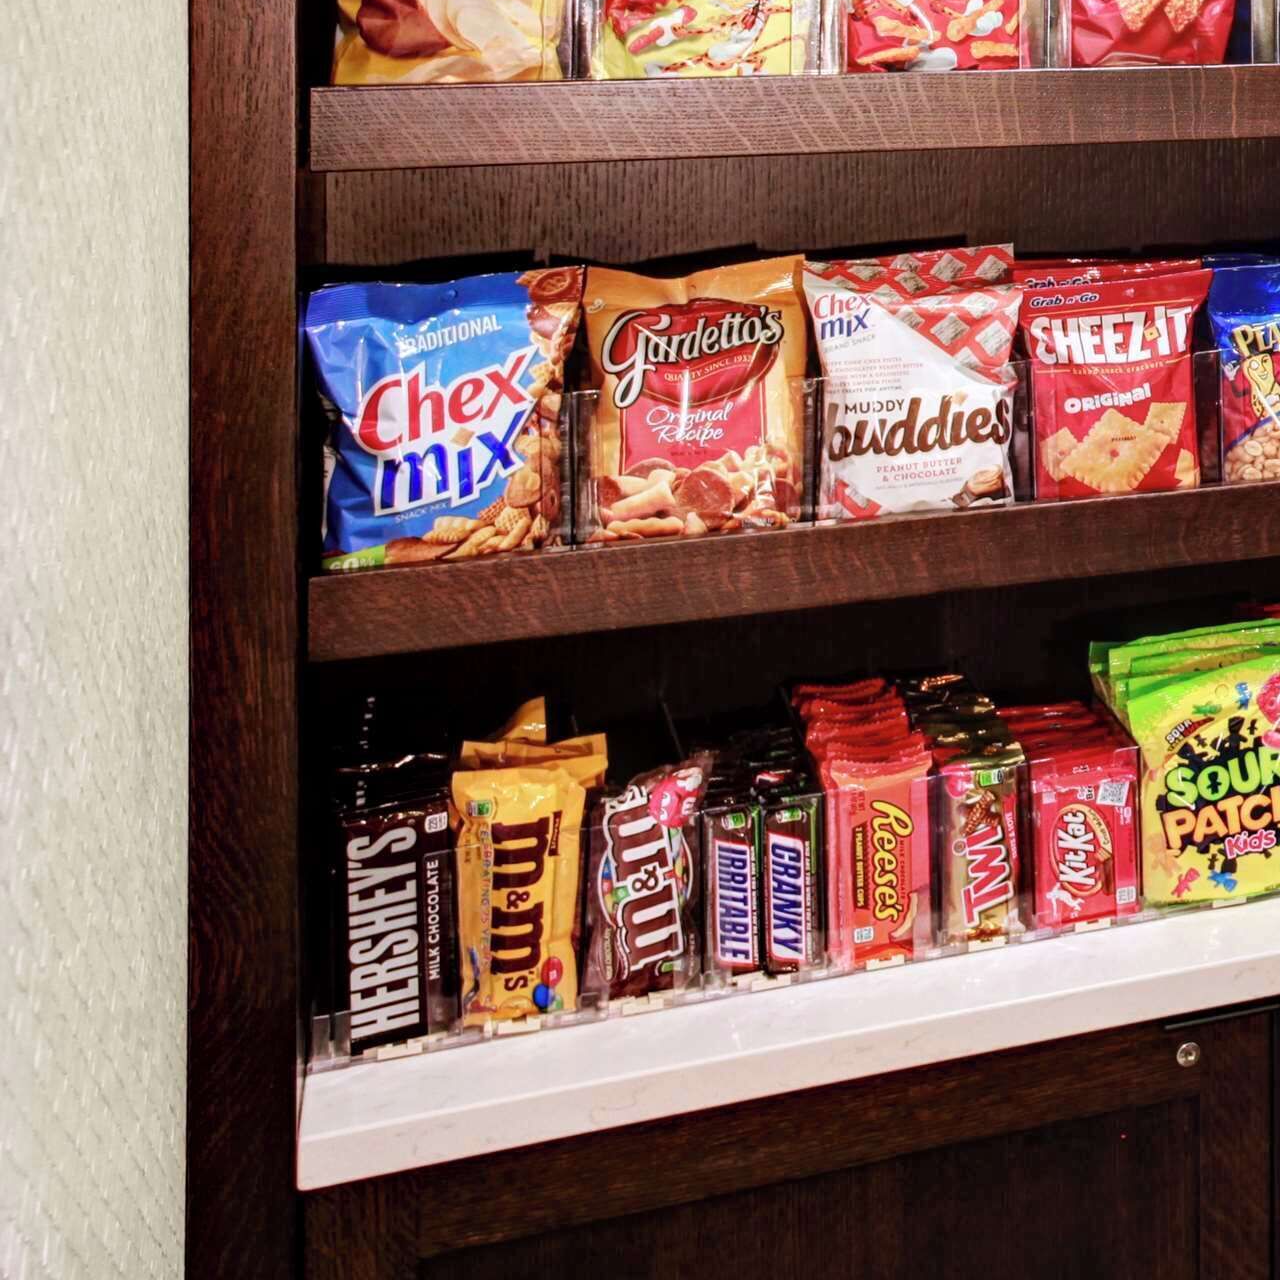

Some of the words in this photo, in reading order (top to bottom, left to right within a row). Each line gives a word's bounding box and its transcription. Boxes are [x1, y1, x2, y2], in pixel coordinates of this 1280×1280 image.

[814, 293, 872, 320] Chex
[1031, 295, 1063, 308] Grab
[1080, 293, 1098, 303] Go
[399, 314, 502, 357] TRADITIONAL
[820, 308, 871, 341] mix
[602, 306, 784, 408] Gardetto's
[703, 360, 732, 375] SINCE
[358, 349, 535, 451] Chex
[845, 398, 904, 416] MUDDY
[645, 403, 731, 434] Original
[827, 394, 1010, 462] buddies
[657, 423, 726, 447] Recipe
[379, 409, 526, 510] mix
[876, 462, 919, 474] PEANUT
[923, 457, 963, 469] BUTTER
[894, 467, 957, 481] CHOCOLATE
[1165, 719, 1194, 744] SOUR
[1224, 829, 1277, 859] Kids
[870, 800, 914, 922] Reese's
[426, 858, 440, 949] CHOCOLATE
[717, 845, 751, 961] IRRITABLE
[770, 841, 803, 956] CRANKY
[347, 824, 420, 1039] HERSHEY'S
[428, 949, 442, 981] MILK
